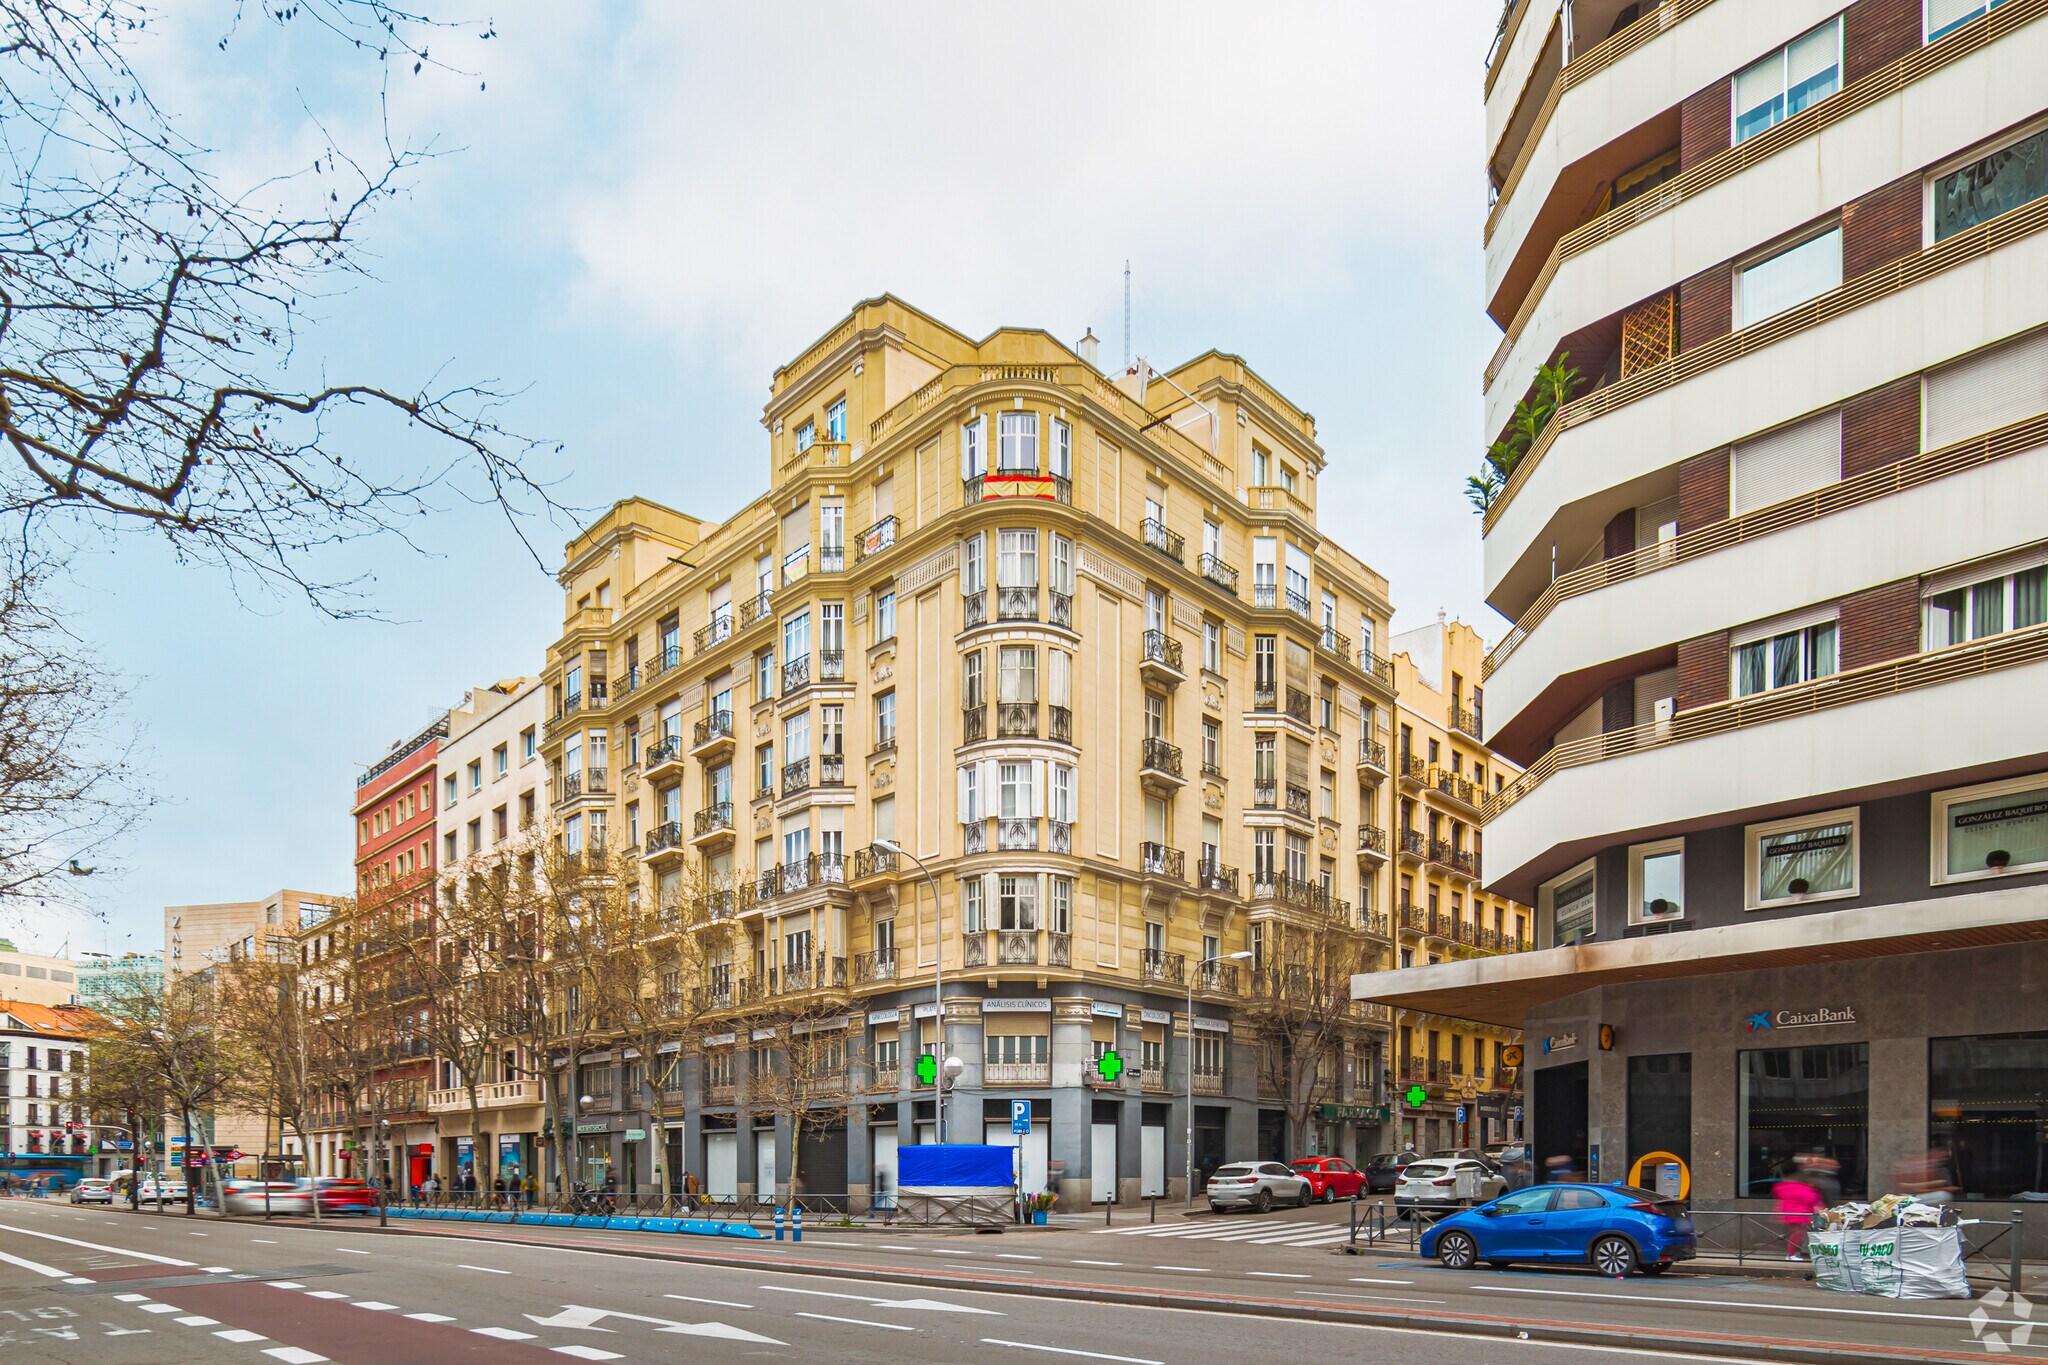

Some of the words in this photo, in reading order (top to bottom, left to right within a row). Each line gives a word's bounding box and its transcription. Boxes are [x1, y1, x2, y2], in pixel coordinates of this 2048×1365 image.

[1958, 811, 2003, 824] GONZÁLEZ
[2005, 804, 2048, 817] BAQUERO
[2006, 817, 2040, 827] DENTAL
[1768, 842, 1807, 855] GONZÁLEZ
[1808, 837, 1844, 848] BAQUERO
[172, 916, 182, 974] ZARA
[986, 999, 1016, 1008] ANÁLISIS
[1017, 999, 1047, 1008] CLÍNICOS
[1776, 1006, 1856, 1025] CaixaBank
[1013, 1102, 1026, 1121] P
[1337, 1106, 1382, 1119] FARMACIA
[1870, 1242, 1895, 1256] SACO
